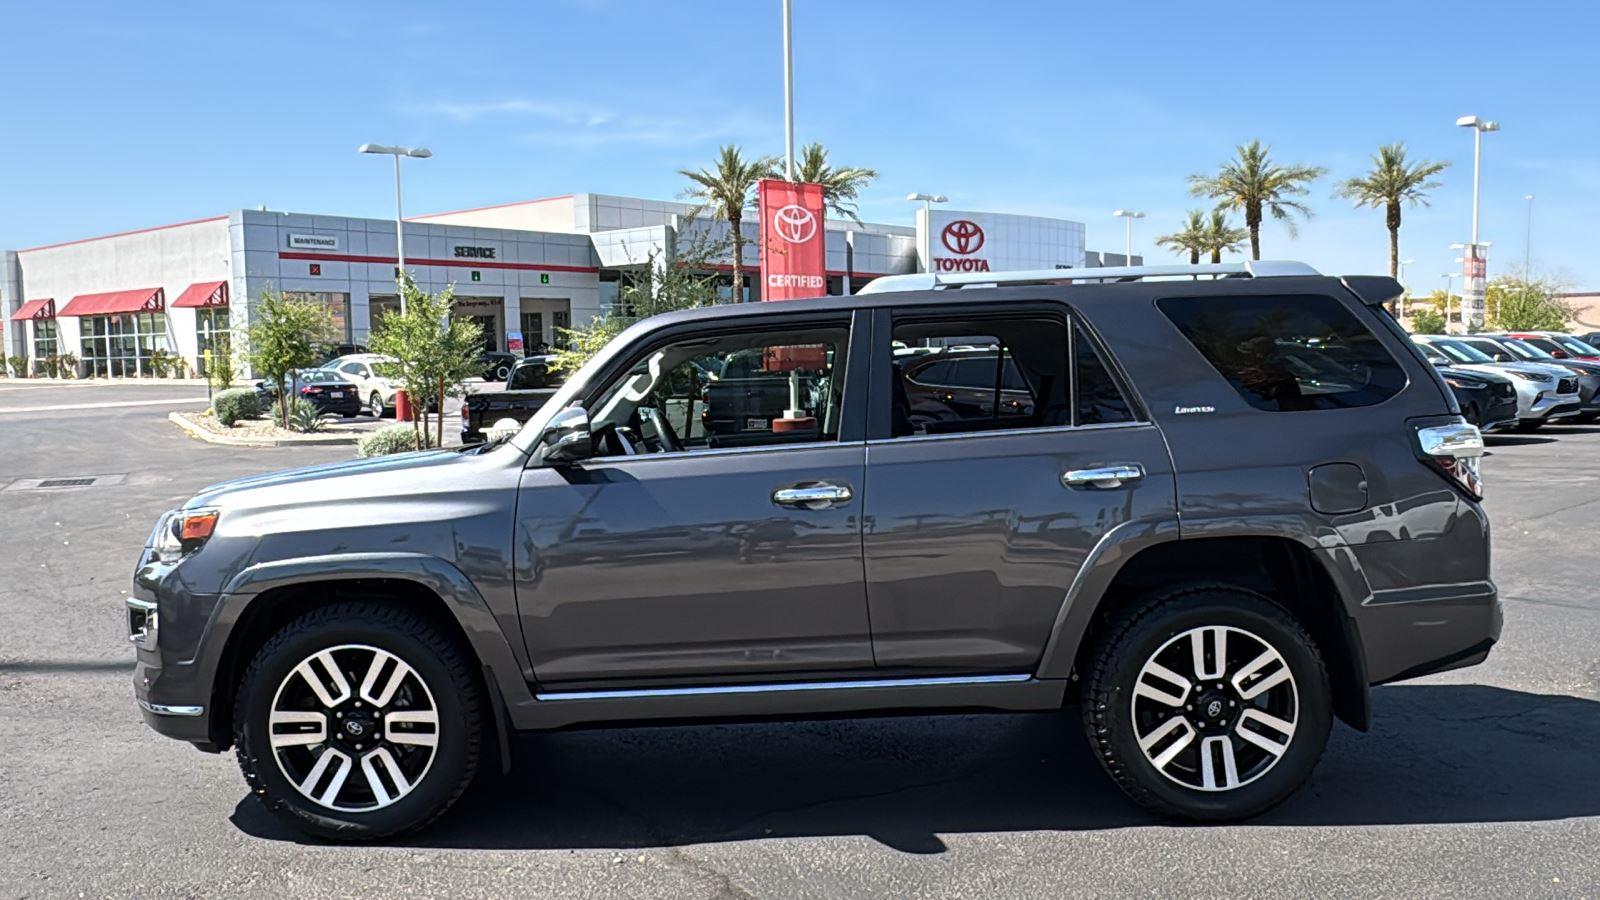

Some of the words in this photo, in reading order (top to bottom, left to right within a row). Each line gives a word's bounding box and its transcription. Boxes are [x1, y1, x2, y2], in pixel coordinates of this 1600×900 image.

[454, 246, 496, 258] SERVICE
[934, 258, 990, 272] TOYOTA
[768, 274, 823, 288] CERTIFIED
